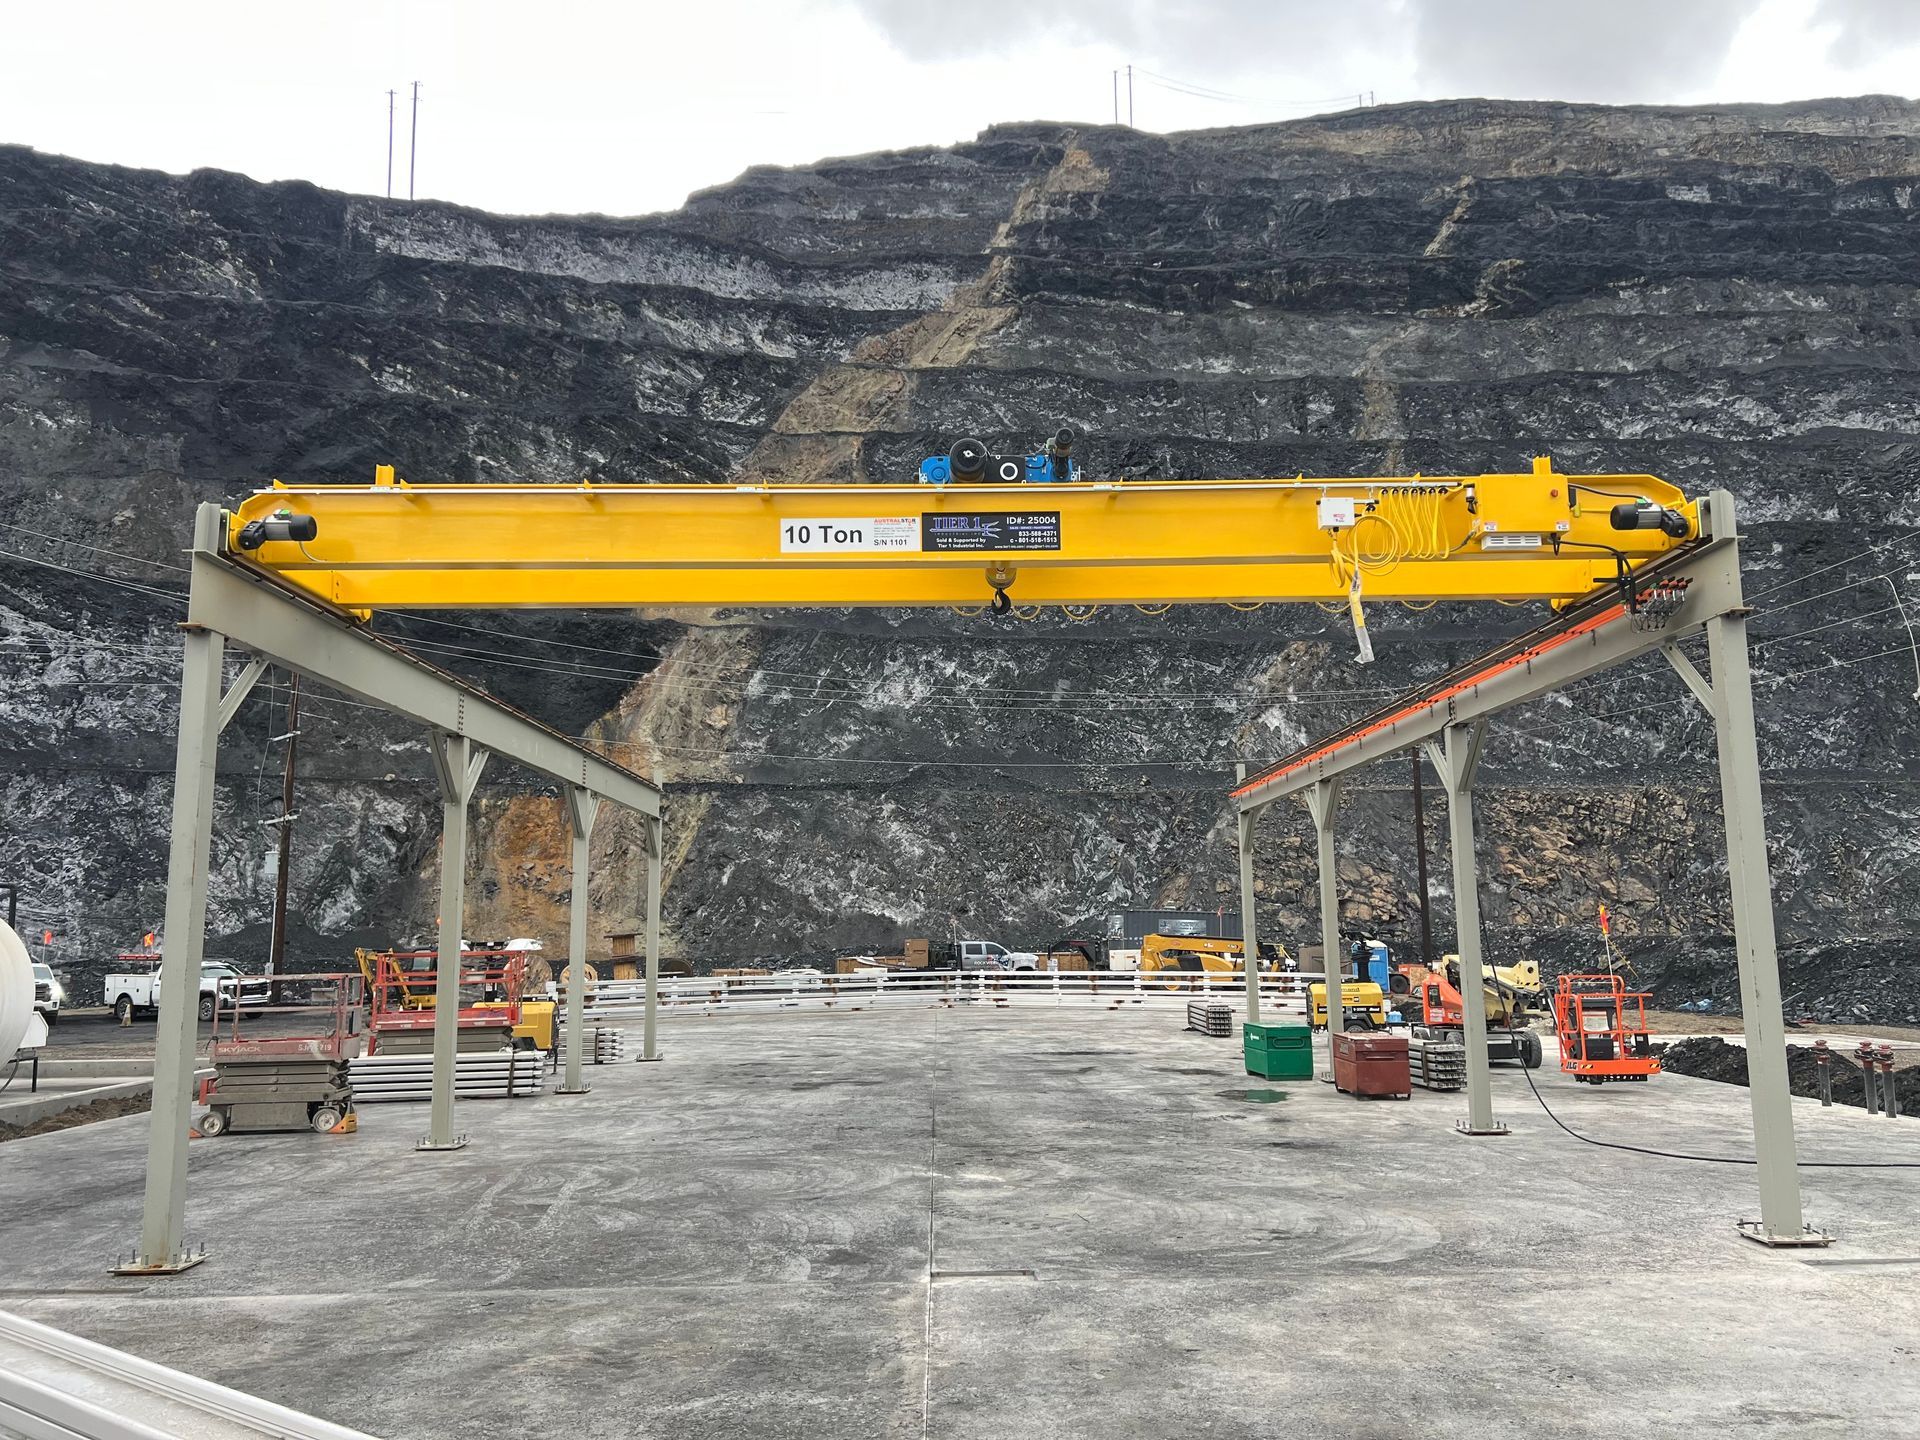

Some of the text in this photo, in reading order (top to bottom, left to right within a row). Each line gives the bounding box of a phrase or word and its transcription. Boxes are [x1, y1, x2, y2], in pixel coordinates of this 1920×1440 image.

[933, 517, 981, 529] TIER 1
[1006, 516, 1057, 524] ID#: 25004
[785, 525, 863, 544] 10 Ton
[218, 1045, 261, 1053] SKYJACK
[1566, 1061, 1577, 1070] JLG
